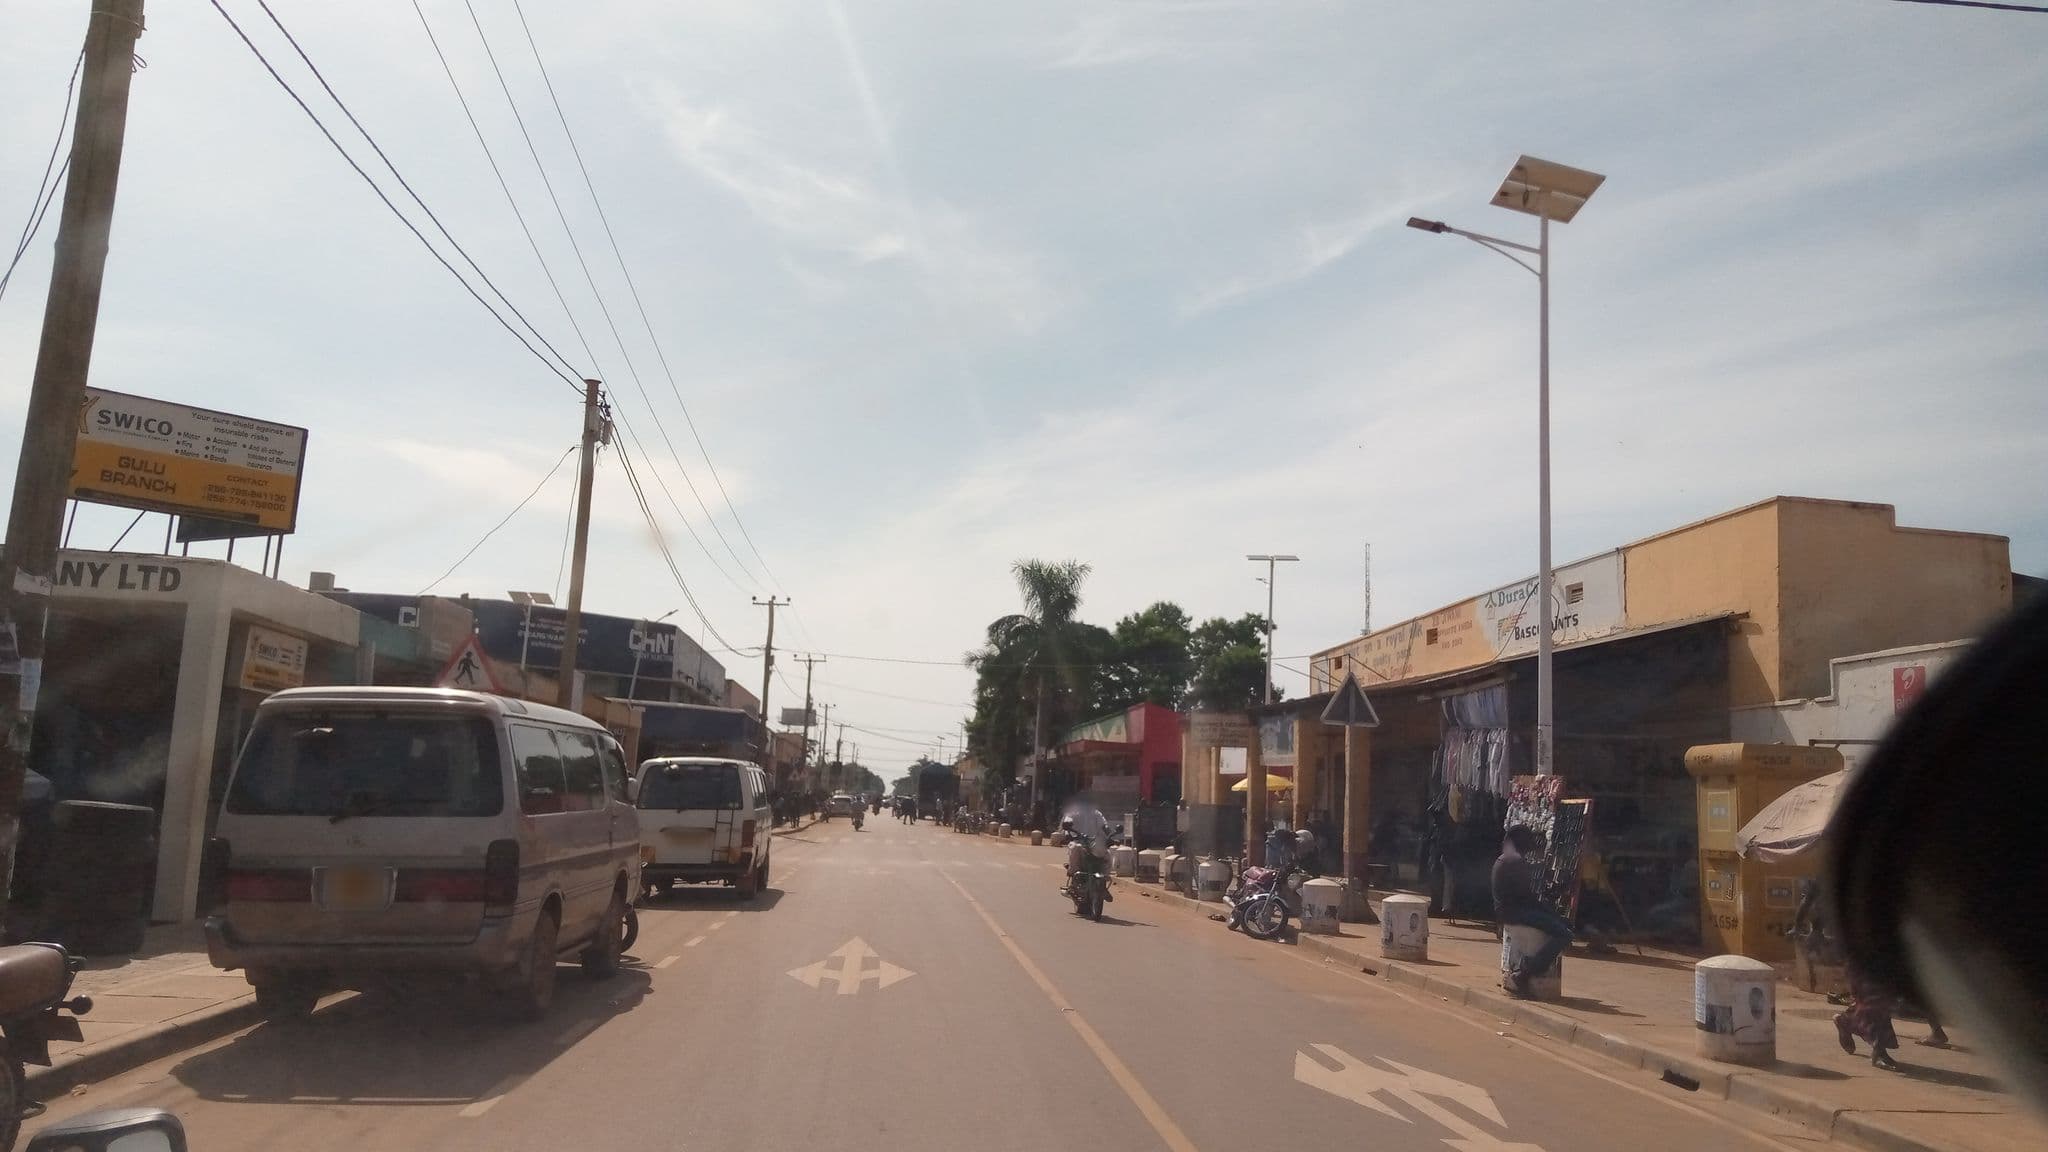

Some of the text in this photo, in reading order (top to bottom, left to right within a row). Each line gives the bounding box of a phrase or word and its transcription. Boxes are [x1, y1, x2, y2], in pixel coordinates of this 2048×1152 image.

[97, 409, 173, 436] SWICO
[118, 456, 166, 475] GULU
[101, 469, 177, 495] BRANCH
[51, 560, 181, 592] NY LTD
